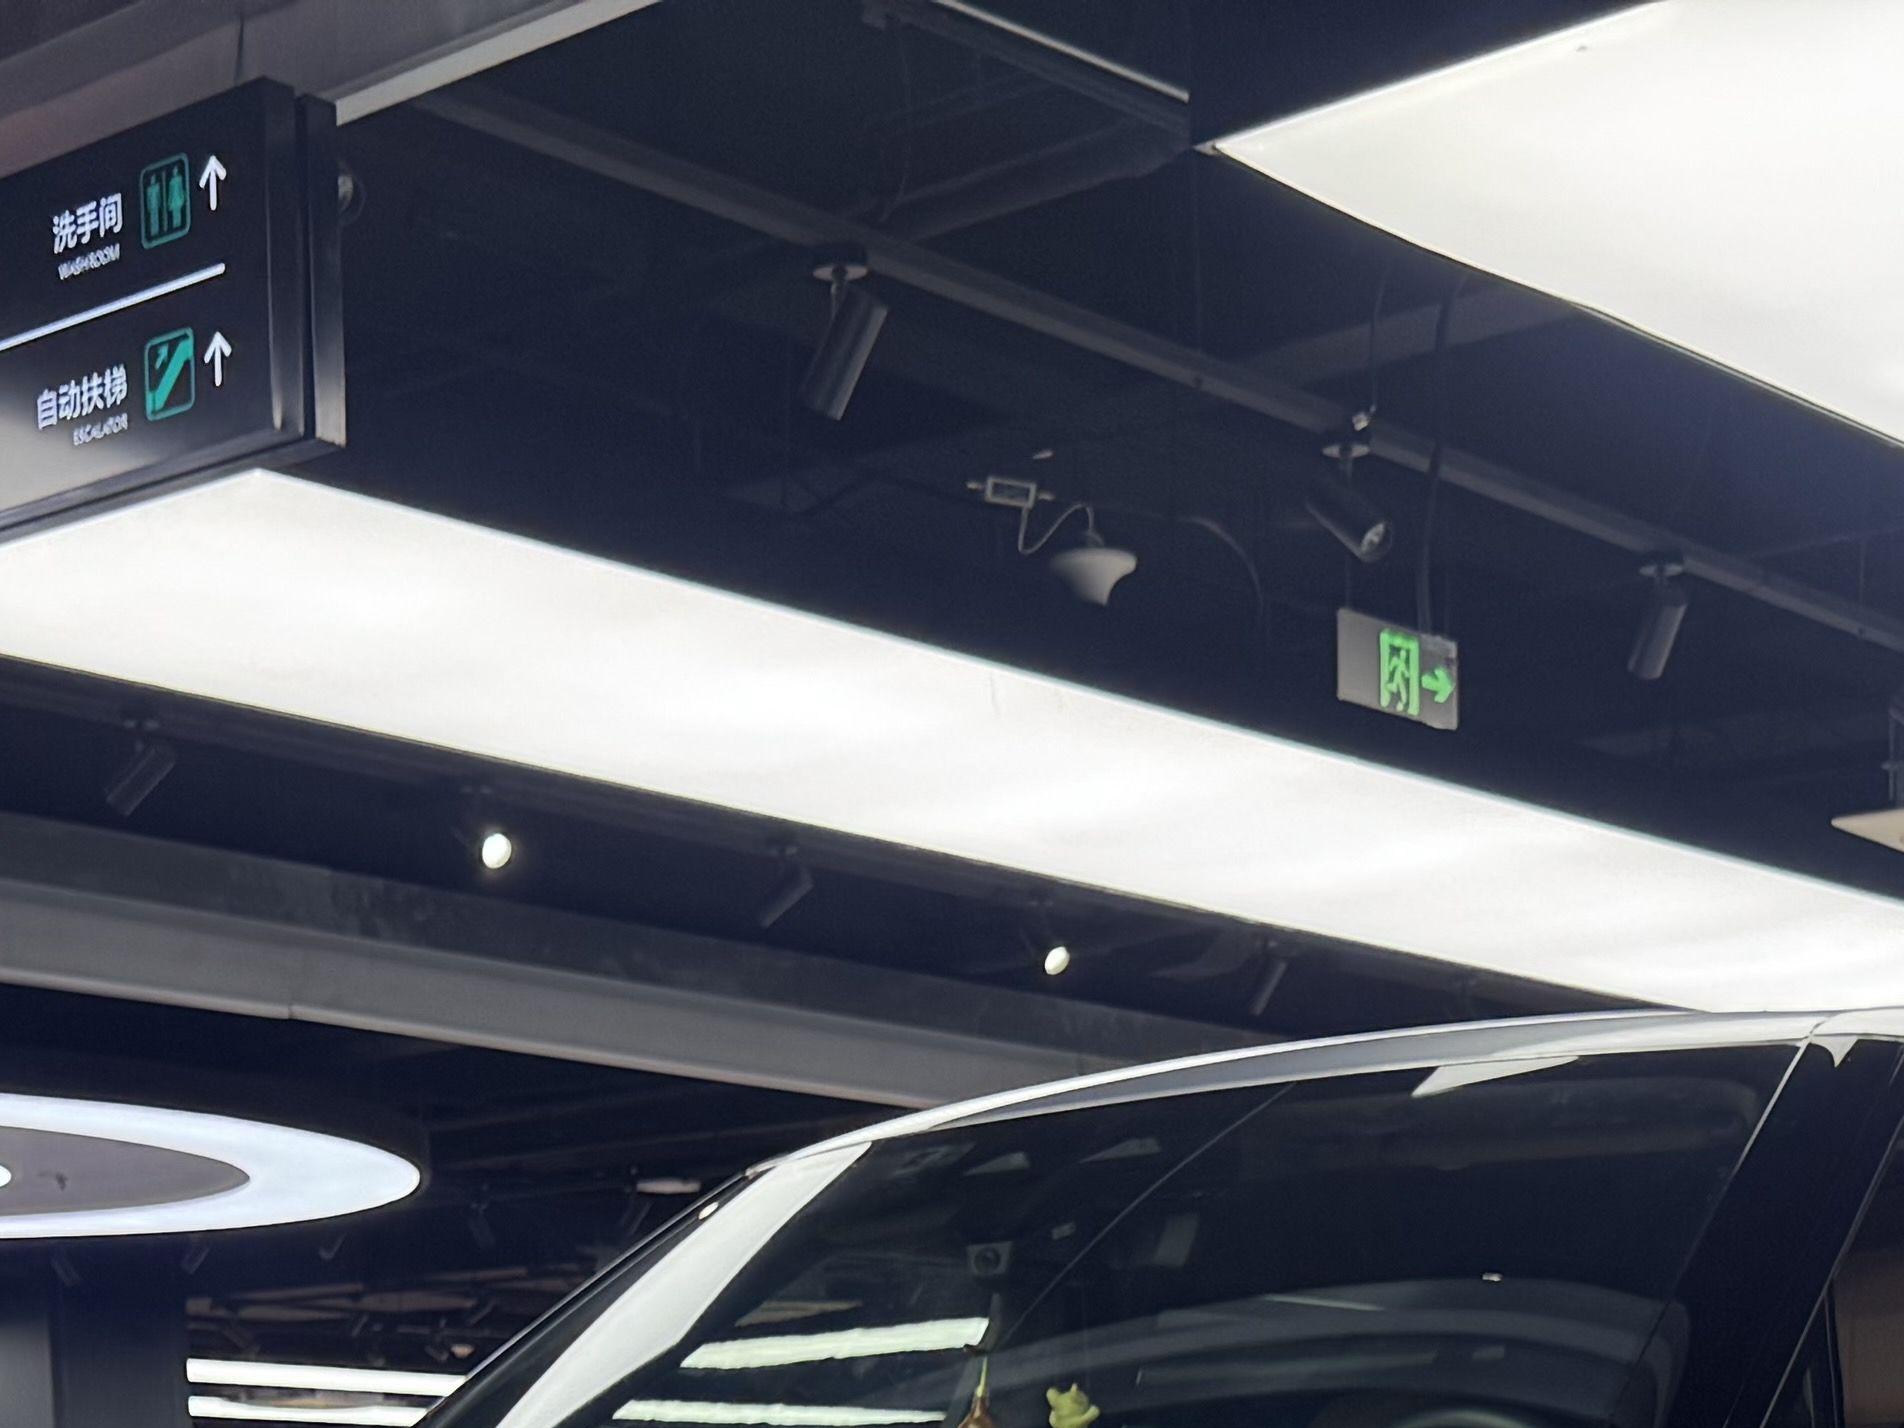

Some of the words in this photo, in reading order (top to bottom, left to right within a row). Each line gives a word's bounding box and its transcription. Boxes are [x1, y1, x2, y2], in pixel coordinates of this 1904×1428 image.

[52, 193, 123, 254] 洗手间
[37, 364, 127, 429] 自动扶梯
